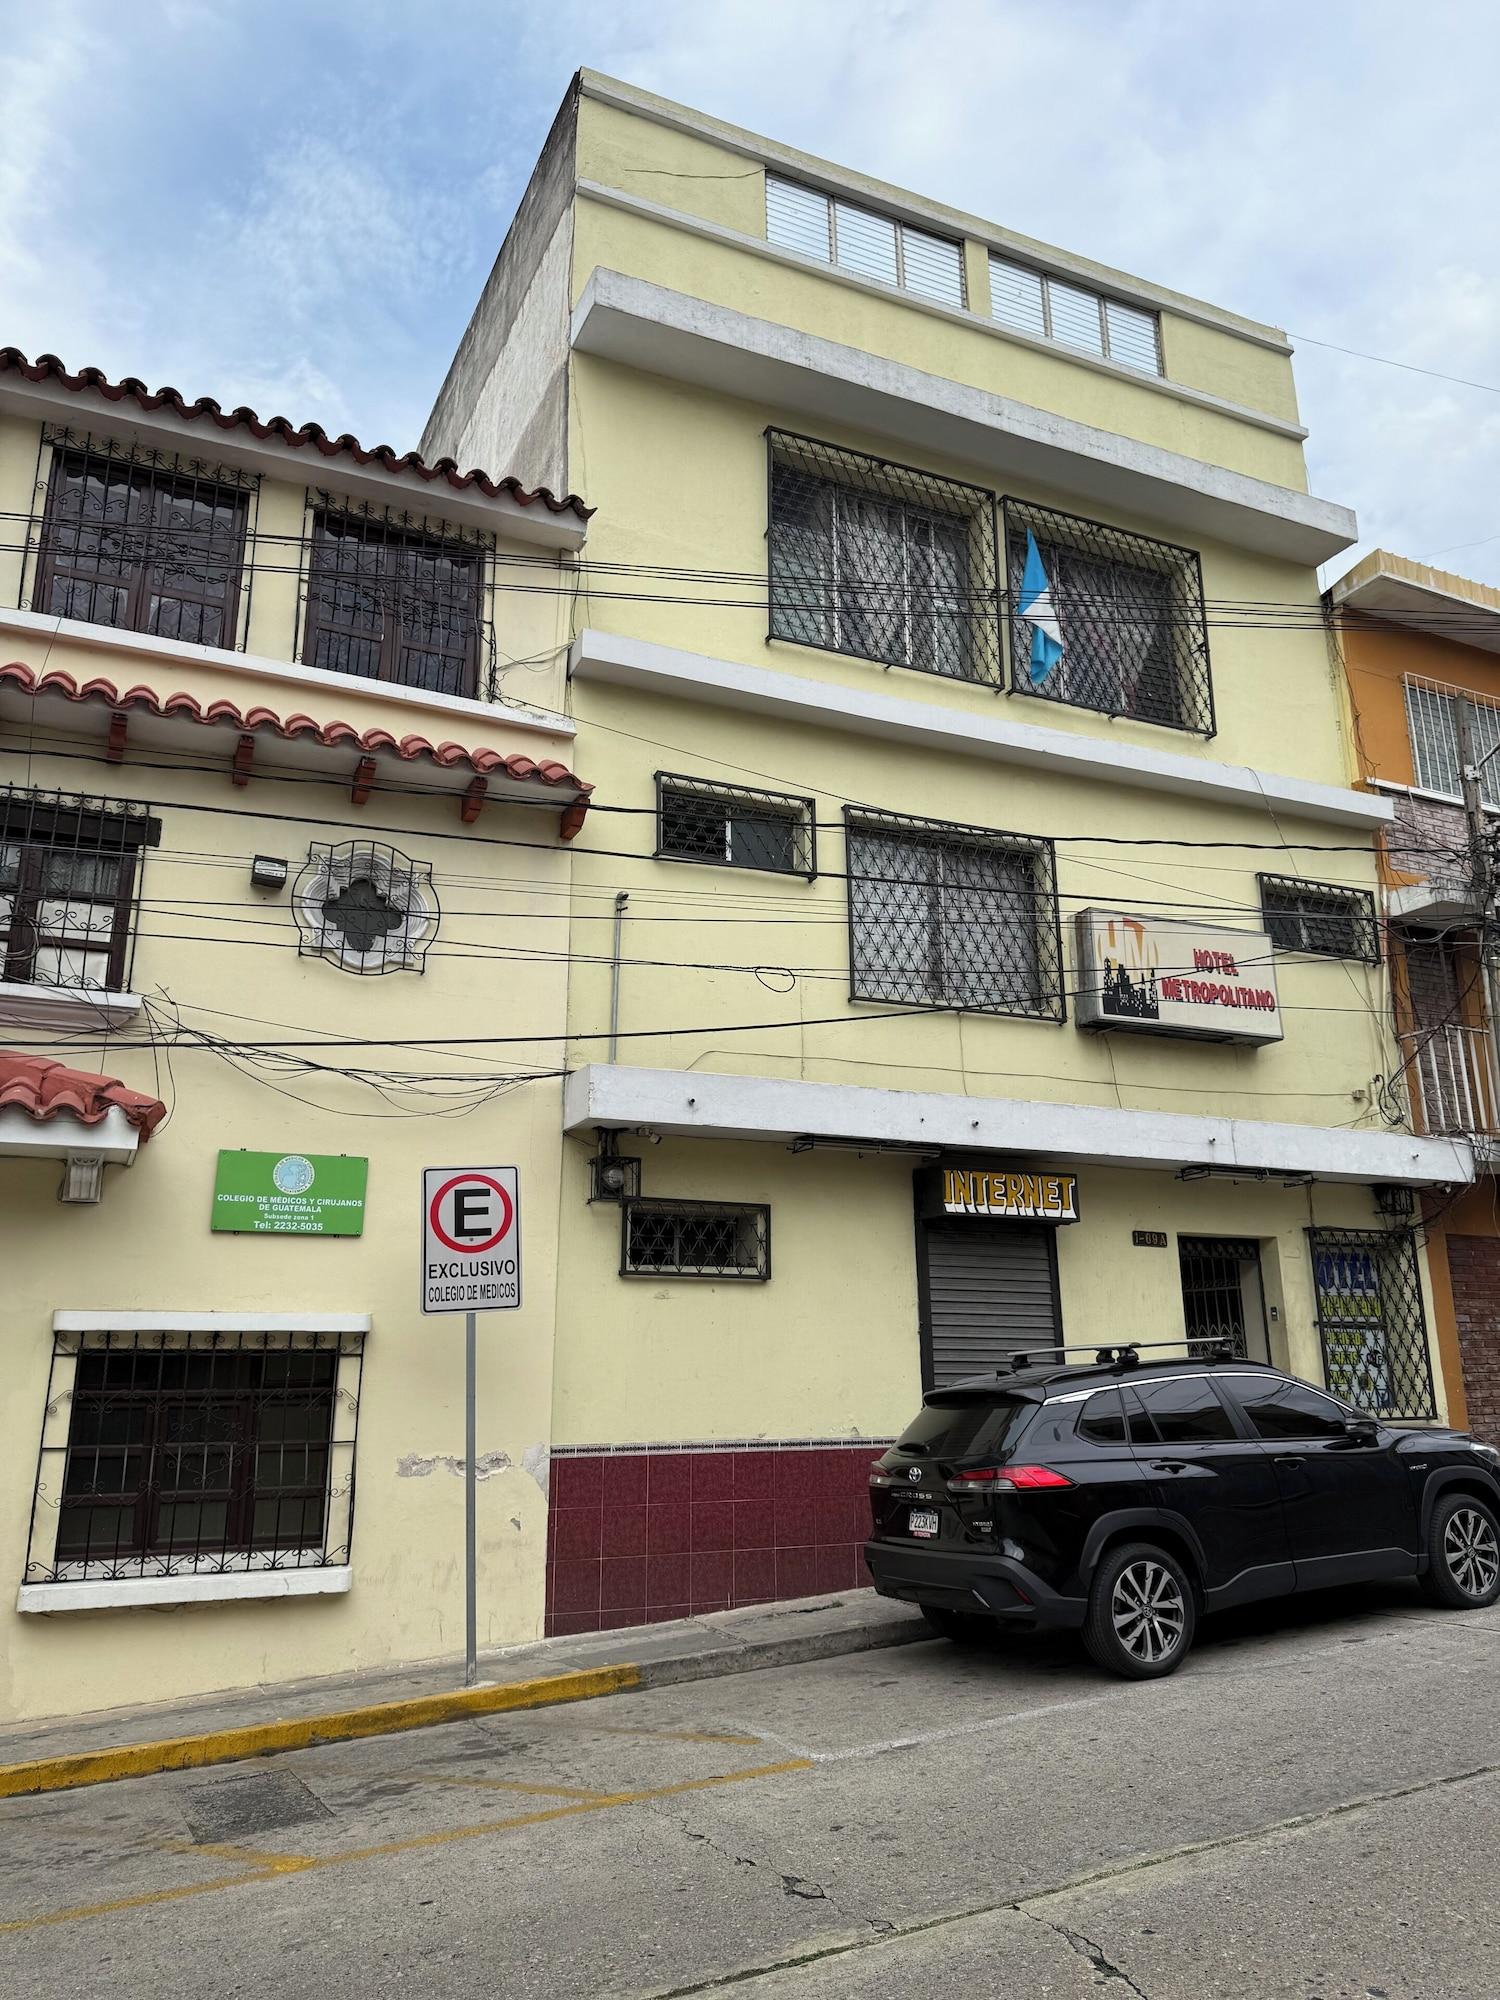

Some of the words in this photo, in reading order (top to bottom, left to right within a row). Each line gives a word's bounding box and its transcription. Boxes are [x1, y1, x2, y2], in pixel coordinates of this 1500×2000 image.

[1193, 949, 1239, 977] HOTEL
[1161, 978, 1276, 1013] METROPOLITANO
[217, 1194, 255, 1202] COLEGIO
[256, 1195, 268, 1203] DE
[317, 1198, 363, 1207] CIRUJANOS
[944, 1169, 1077, 1219] INTERNET
[272, 1204, 322, 1213] GUATEMALA
[454, 1188, 491, 1237] E
[254, 1221, 271, 1229] Tel:
[274, 1221, 324, 1231] 2232-5035
[428, 1259, 516, 1279] EXCLUSIVO
[428, 1285, 465, 1303] COLEGIO
[467, 1284, 478, 1301] DE
[480, 1282, 516, 1300] MEDICOS
